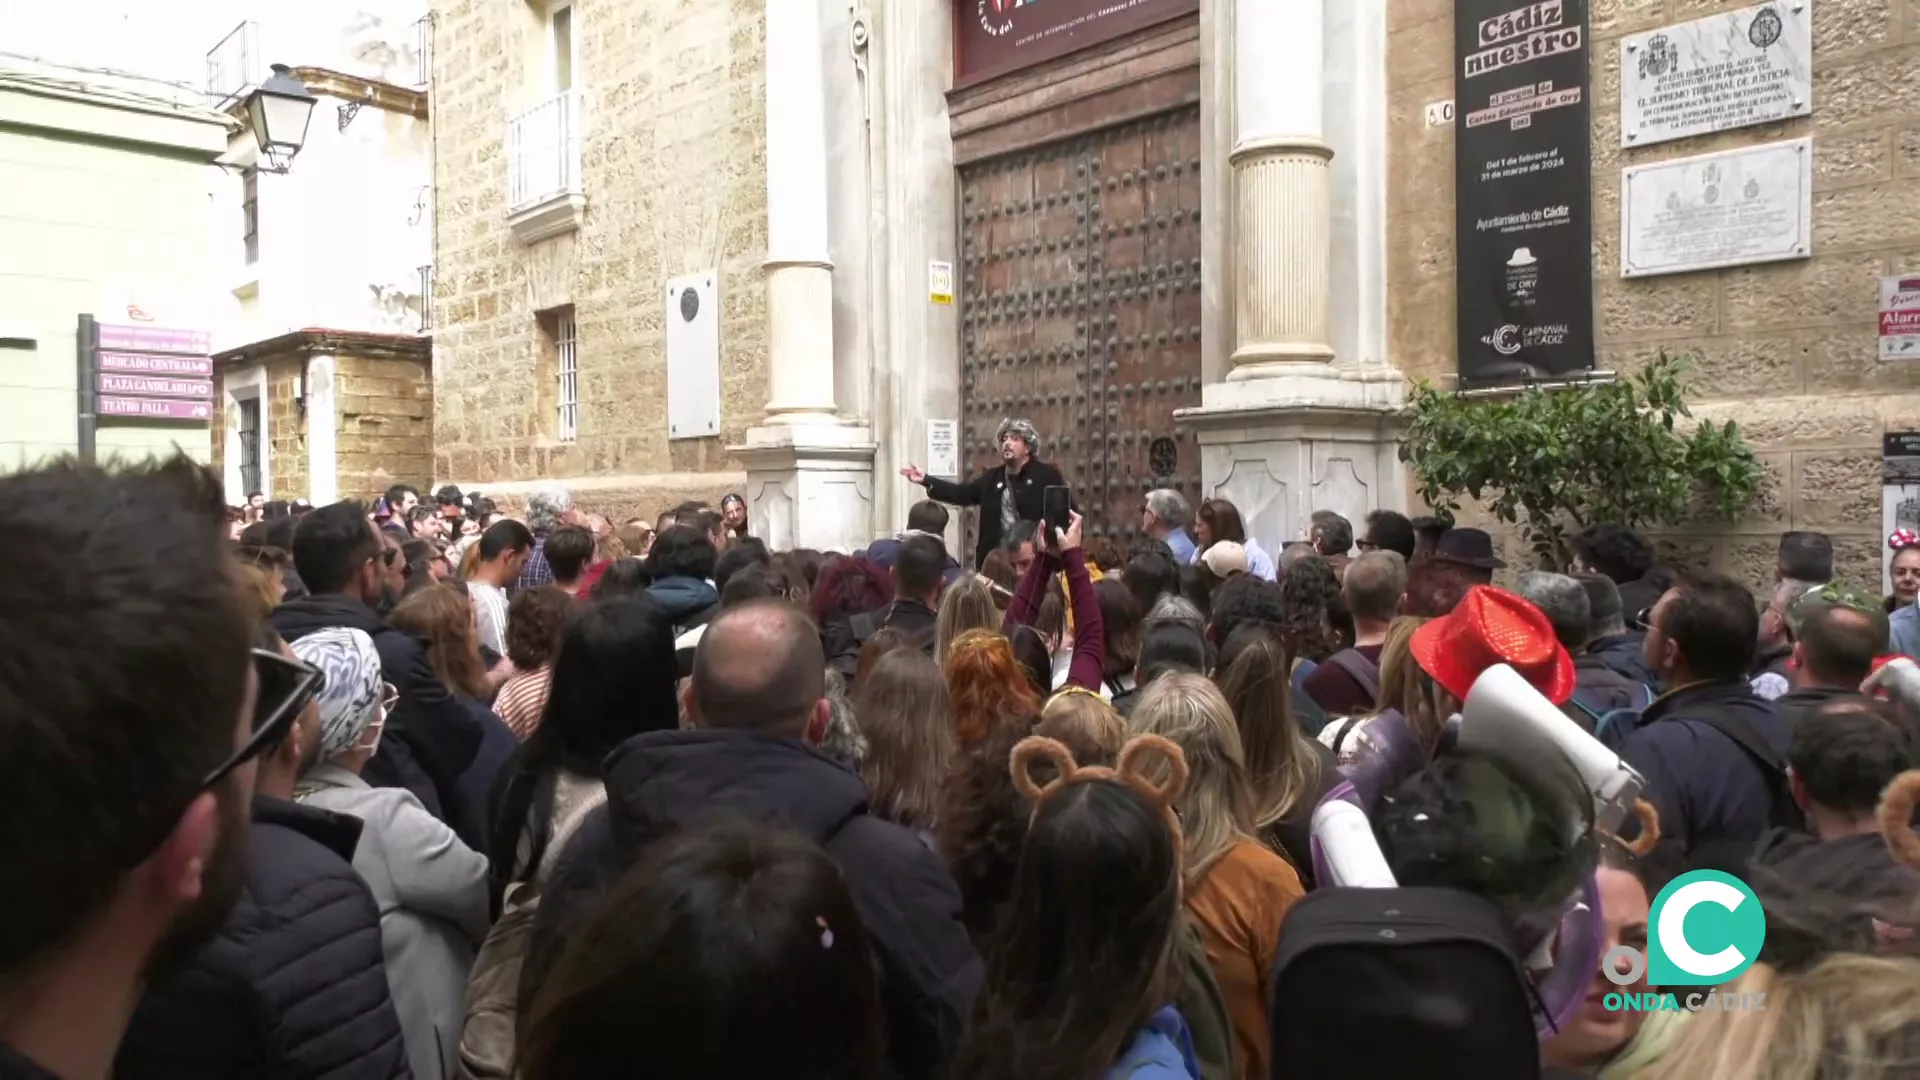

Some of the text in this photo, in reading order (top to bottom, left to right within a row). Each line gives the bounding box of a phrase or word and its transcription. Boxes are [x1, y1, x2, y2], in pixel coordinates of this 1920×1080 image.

[1098, 2, 1128, 17] CARNAVAL
[1480, 2, 1562, 43] Cádiz
[1467, 30, 1579, 75] nuestro
[1540, 82, 1551, 93] de
[1637, 67, 1789, 108] EL SUPREMO TRIBUNAL DE JUSTICIA
[1468, 92, 1580, 125] Carlos Edmundo de Ory
[1486, 160, 1499, 170] Del
[1507, 157, 1517, 166] de
[1519, 150, 1548, 164] febrero
[1549, 147, 1558, 157] al
[1491, 171, 1501, 179] de
[1502, 167, 1528, 177] marzo
[1529, 163, 1540, 172] de
[1541, 157, 1565, 171] 2024
[1476, 205, 1569, 233] Ayuntamiento de Cádiz
[1507, 279, 1537, 291] DE ORY
[1522, 323, 1568, 338] CARNAVAL
[1523, 338, 1533, 347] DE
[102, 355, 193, 371] MERCADO CENTRAL
[103, 378, 133, 390] PLAZA
[103, 400, 170, 414] TEATRO FALLA
